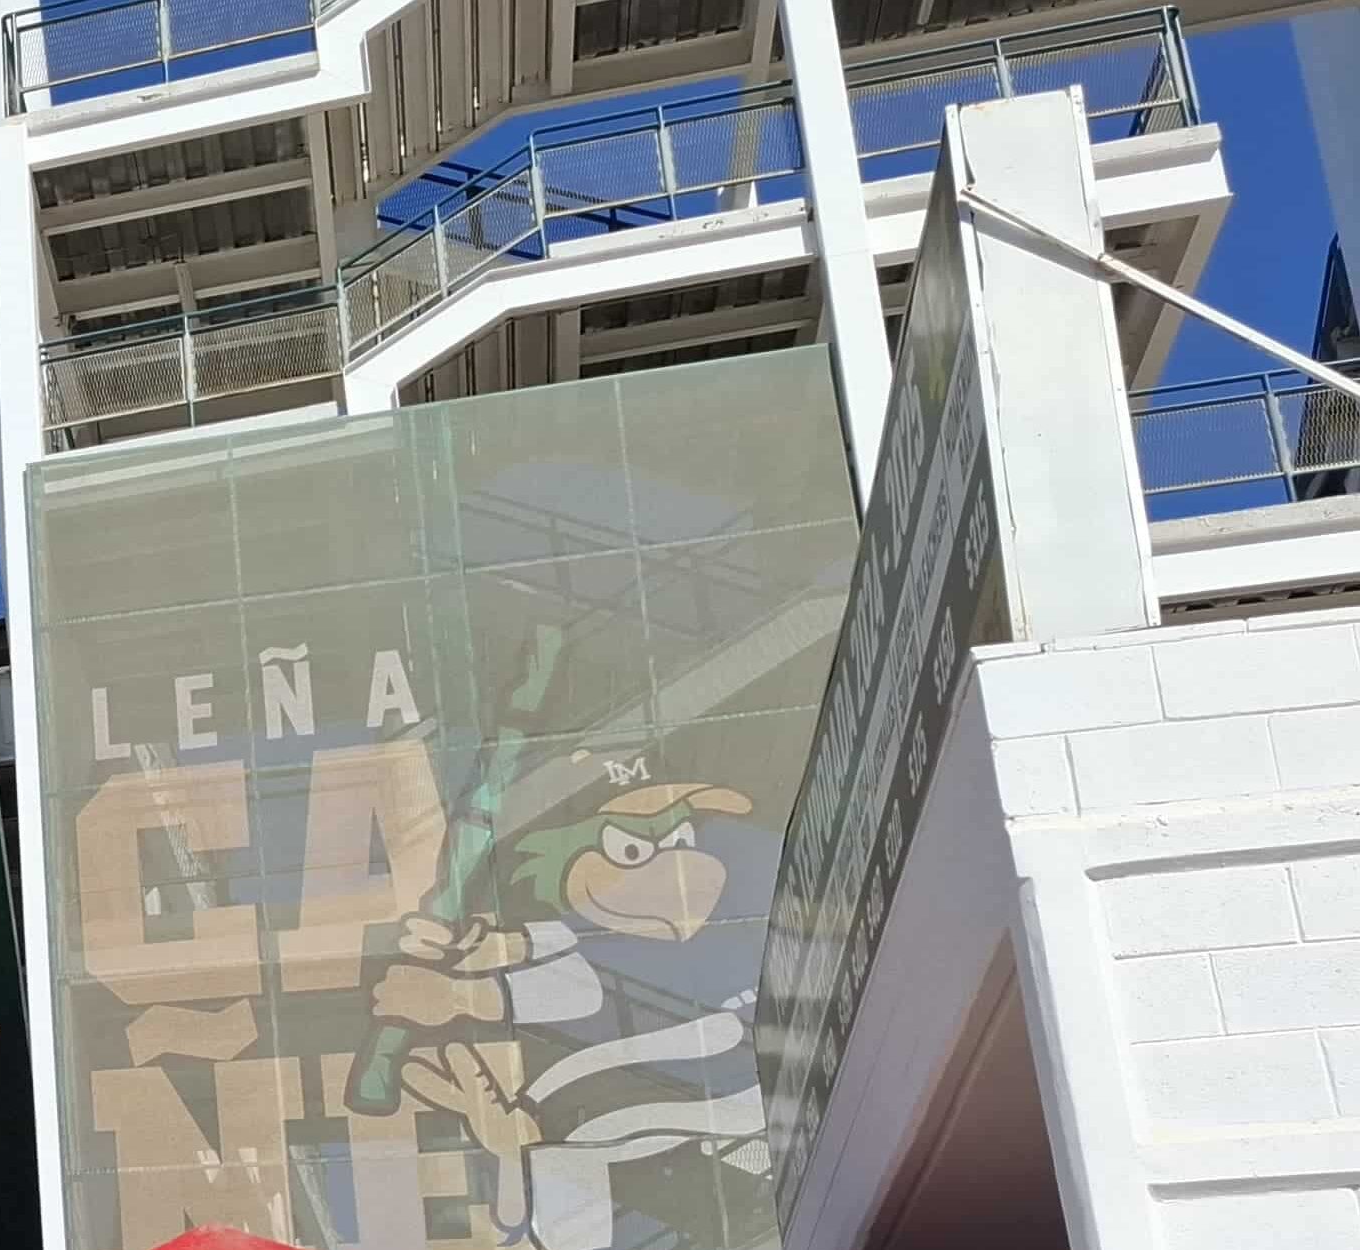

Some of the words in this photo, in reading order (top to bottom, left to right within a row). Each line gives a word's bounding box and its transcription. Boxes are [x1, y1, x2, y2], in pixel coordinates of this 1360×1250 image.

[849, 525, 884, 715] 2024
[884, 346, 924, 565] 2025
[964, 476, 989, 596] $315
[91, 643, 421, 762] LEÑA
[932, 604, 955, 709] $150
[907, 709, 927, 800] $175
[76, 738, 449, 1005] CA
